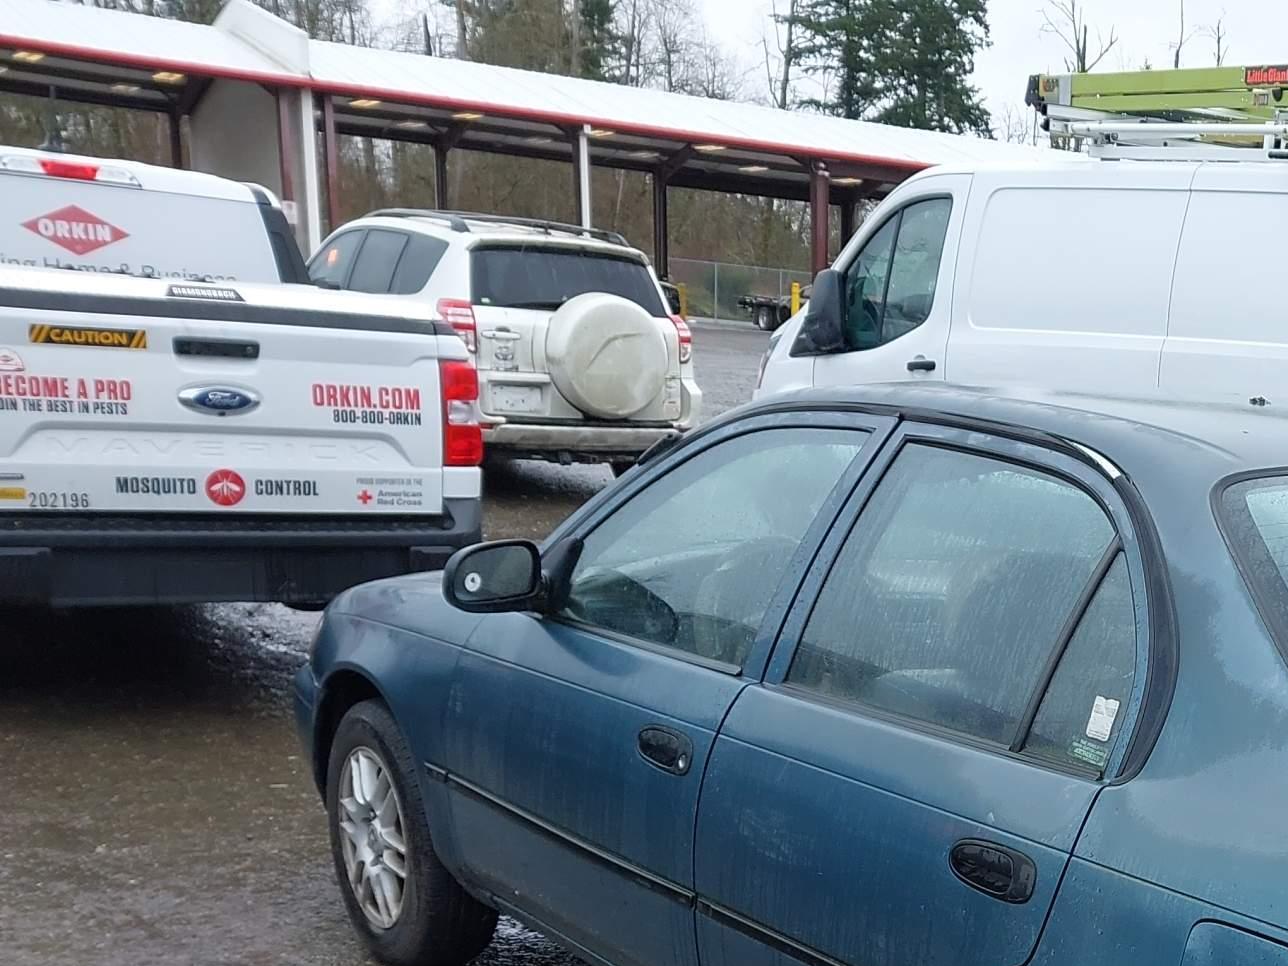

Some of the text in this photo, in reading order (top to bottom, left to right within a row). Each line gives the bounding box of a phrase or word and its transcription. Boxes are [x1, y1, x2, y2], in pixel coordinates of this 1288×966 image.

[37, 218, 113, 242] ORKIN
[49, 328, 129, 345] CAUTION
[0, 374, 132, 401] ECOME A PRO
[311, 383, 421, 410] ORKIN.COM
[22, 398, 42, 412] THE
[46, 399, 74, 413] BEST
[78, 400, 90, 414] IN
[93, 401, 128, 415] PESTS
[333, 409, 422, 427] 800-800-ORKIN
[45, 436, 380, 462] MAVERICK
[115, 476, 320, 497] MOSQUITO CONTROL
[377, 489, 423, 498] American
[29, 491, 90, 509] 202196
[377, 498, 422, 506] Red Cross
